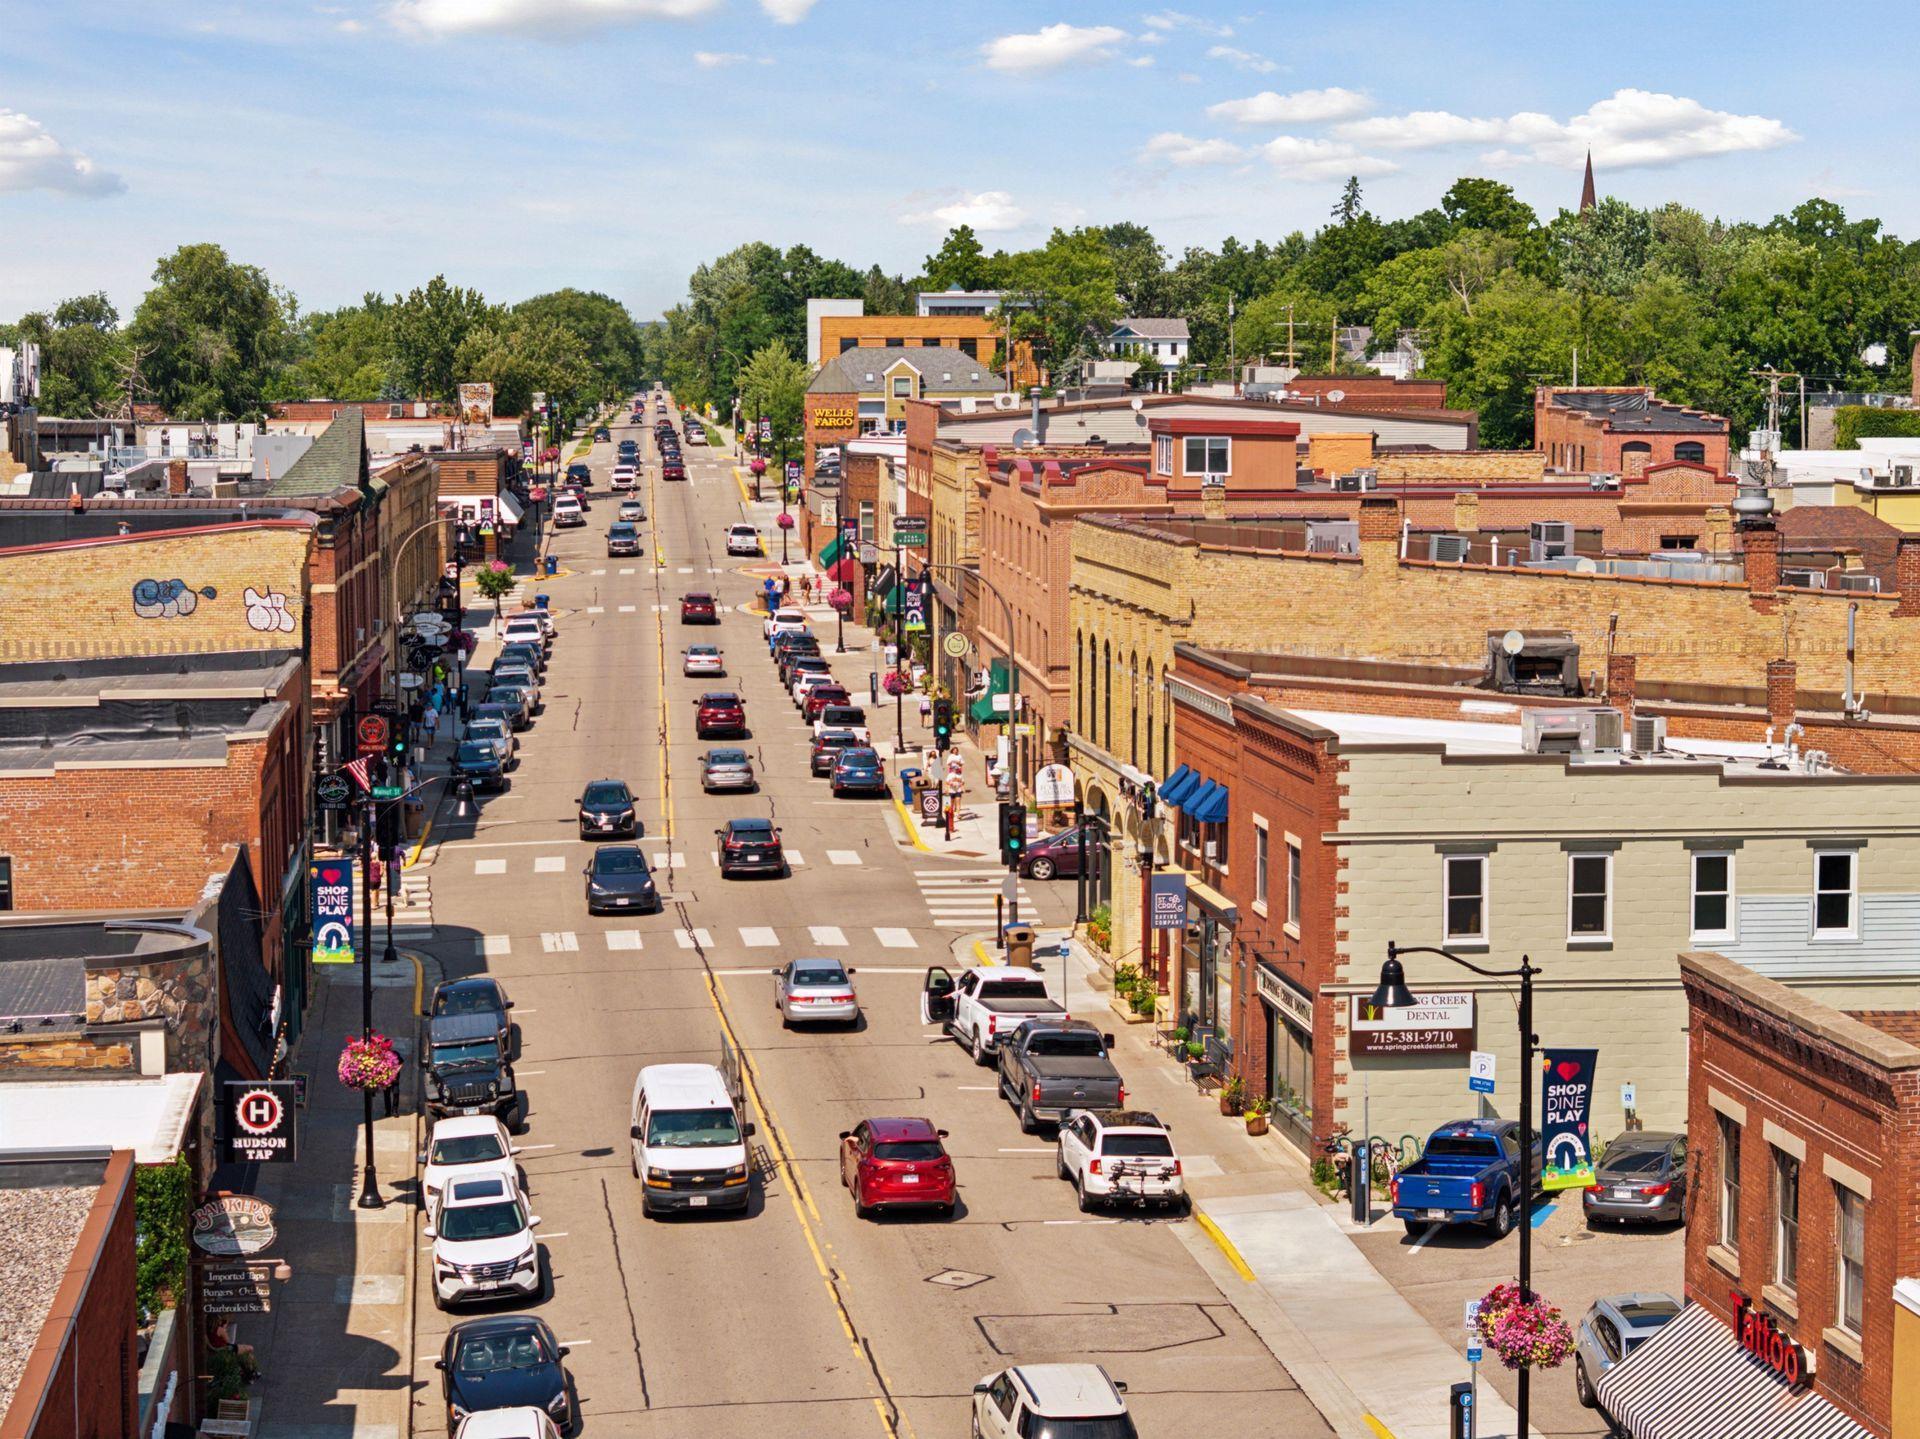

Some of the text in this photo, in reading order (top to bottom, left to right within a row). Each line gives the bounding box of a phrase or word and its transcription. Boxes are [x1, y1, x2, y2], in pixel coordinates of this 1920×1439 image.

[814, 408, 854, 418] WELLS
[814, 417, 853, 426] FARGO
[317, 886, 349, 895] SHOP
[317, 895, 349, 905] DINE
[318, 906, 348, 915] PLAY
[1431, 995, 1468, 1005] CREEK
[1406, 1011, 1450, 1021] DENTAL
[1372, 1030, 1454, 1043] 715-381-9710
[1366, 1043, 1458, 1051] www.springcreekdental.net
[1547, 1084, 1587, 1096] SHOP
[1547, 1095, 1586, 1111] DINE
[249, 1101, 270, 1122] H
[1547, 1109, 1584, 1124] PLAY
[232, 1137, 287, 1149] HUDSON
[246, 1149, 273, 1160] TAP
[208, 1271, 265, 1281] Imported Taps
[203, 1288, 234, 1297] Burgers
[203, 1303, 271, 1312] Charbroiled Steak
[1729, 1291, 1799, 1385] Tattoo
